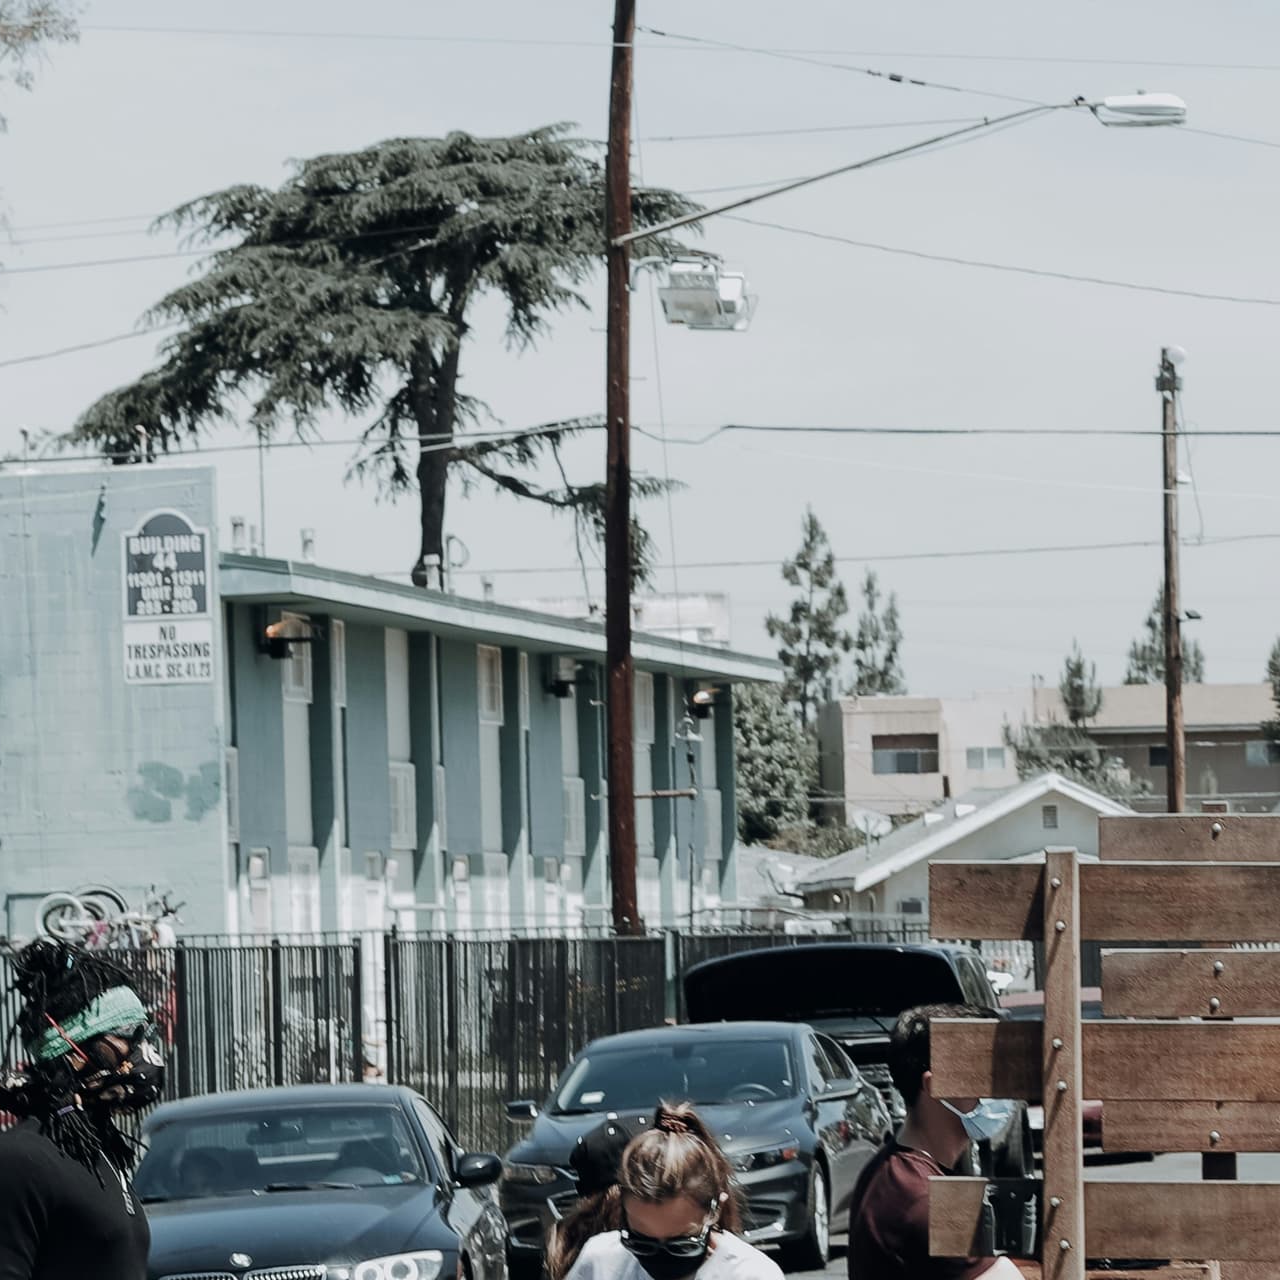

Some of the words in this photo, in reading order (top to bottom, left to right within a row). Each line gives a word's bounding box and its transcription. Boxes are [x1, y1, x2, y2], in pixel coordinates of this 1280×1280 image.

[129, 535, 201, 555] BUILDING
[152, 552, 177, 570] 44
[141, 586, 171, 601] UNIT
[159, 626, 176, 640] NO
[127, 642, 210, 660] TRESPASSING
